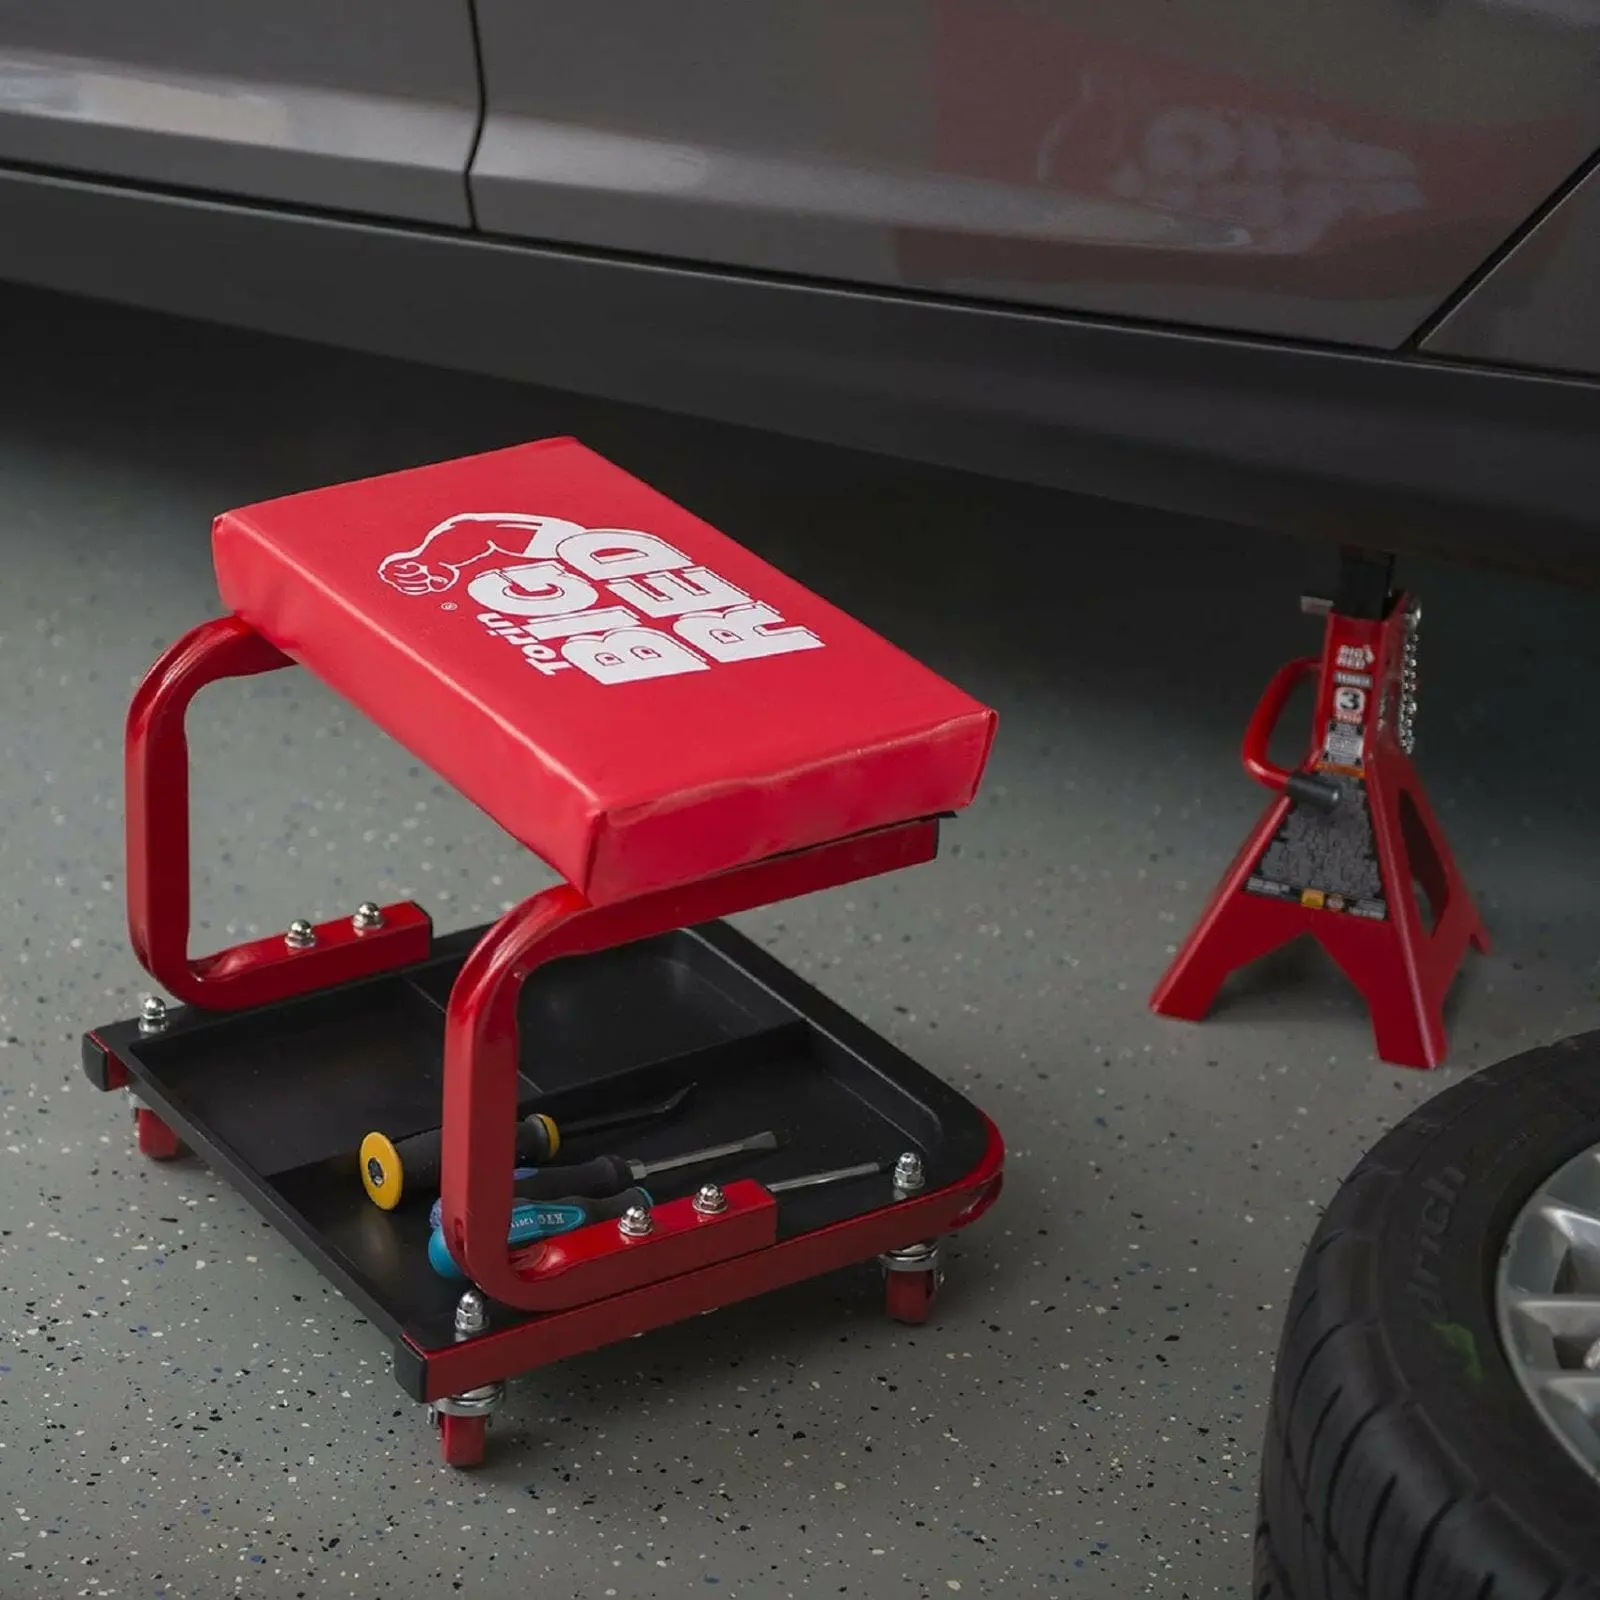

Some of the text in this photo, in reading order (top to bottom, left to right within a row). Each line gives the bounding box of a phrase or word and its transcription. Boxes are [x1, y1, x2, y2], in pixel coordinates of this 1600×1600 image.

[467, 559, 711, 685] BIG
[555, 528, 826, 663] RED
[1340, 691, 1360, 710] 3
